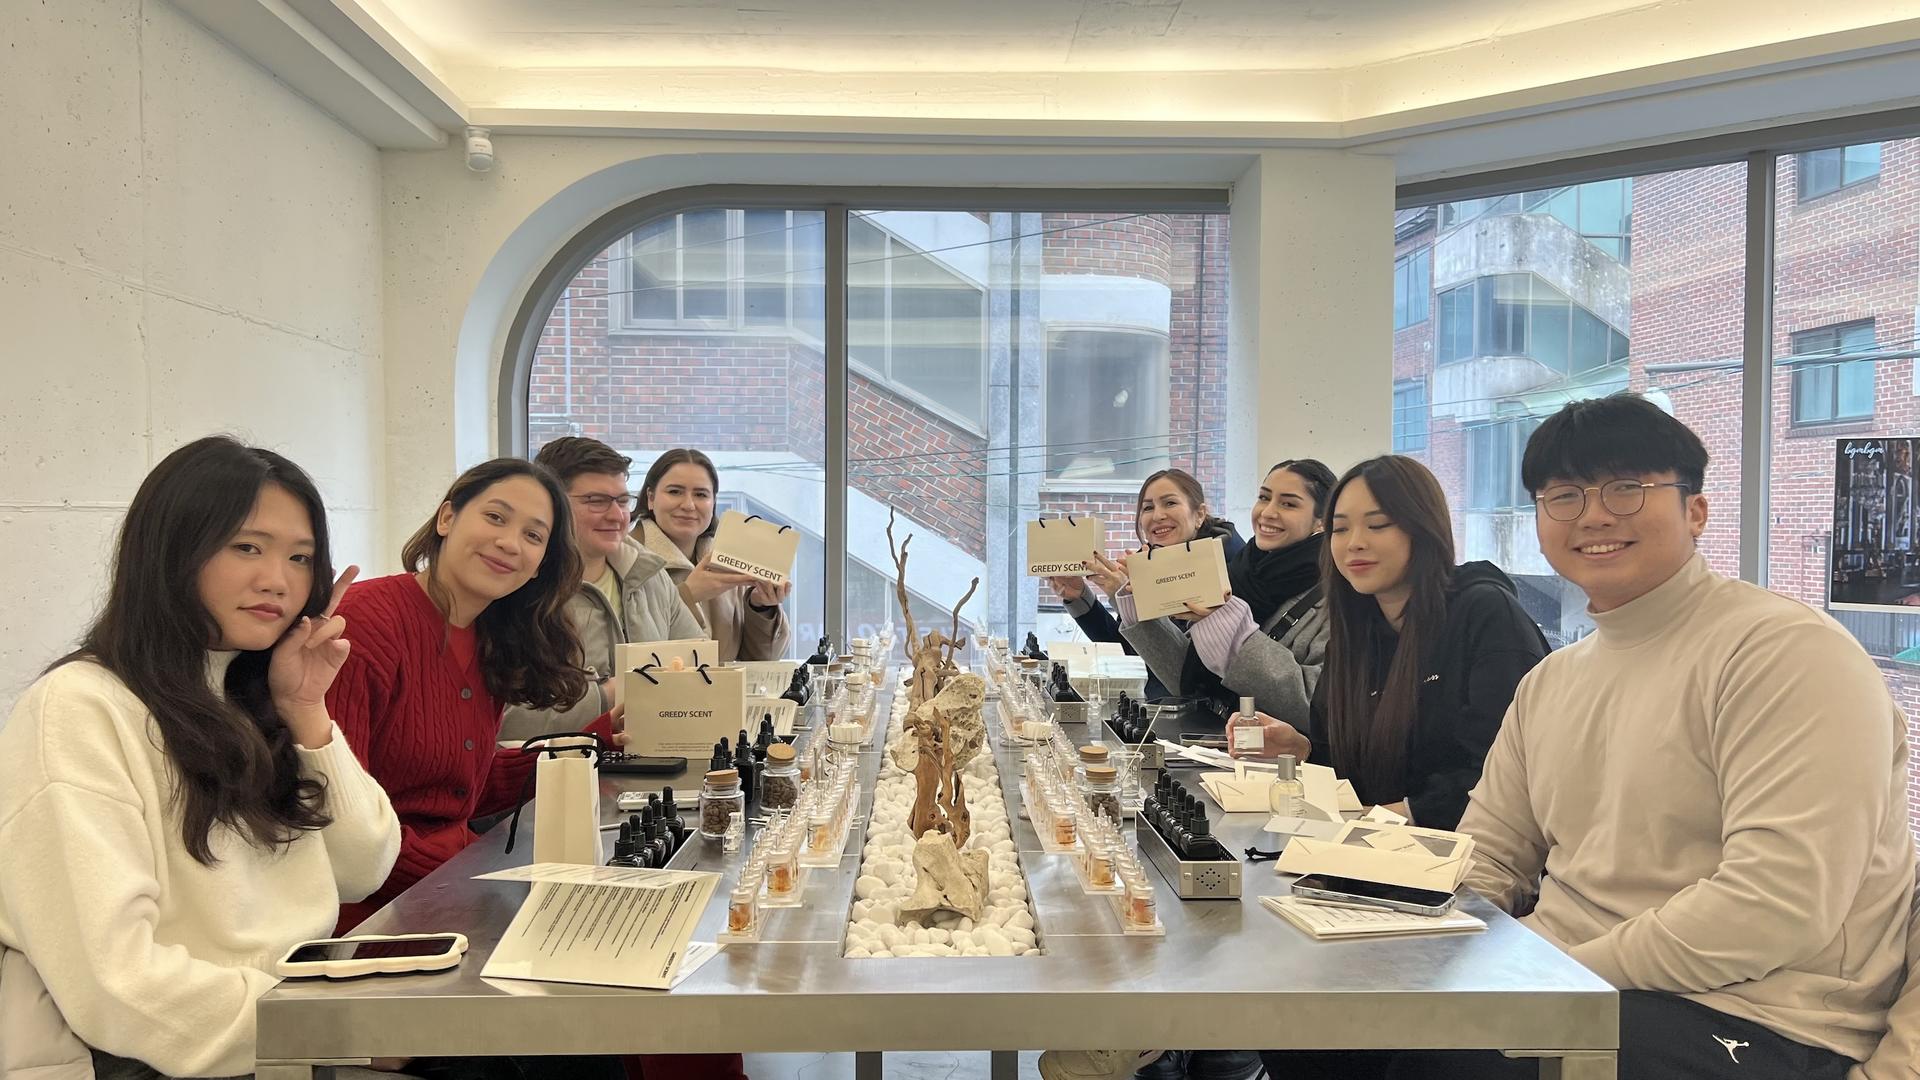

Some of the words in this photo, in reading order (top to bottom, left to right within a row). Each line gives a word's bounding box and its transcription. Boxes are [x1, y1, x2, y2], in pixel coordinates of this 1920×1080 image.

[717, 554, 753, 572] GREEDY
[753, 566, 783, 582] SCENT
[1031, 564, 1063, 573] GREEDY
[1155, 576, 1178, 585] GREEDY
[1177, 572, 1196, 581] SCENT
[659, 710, 688, 718] GREEDY
[689, 710, 713, 718] SCENT
